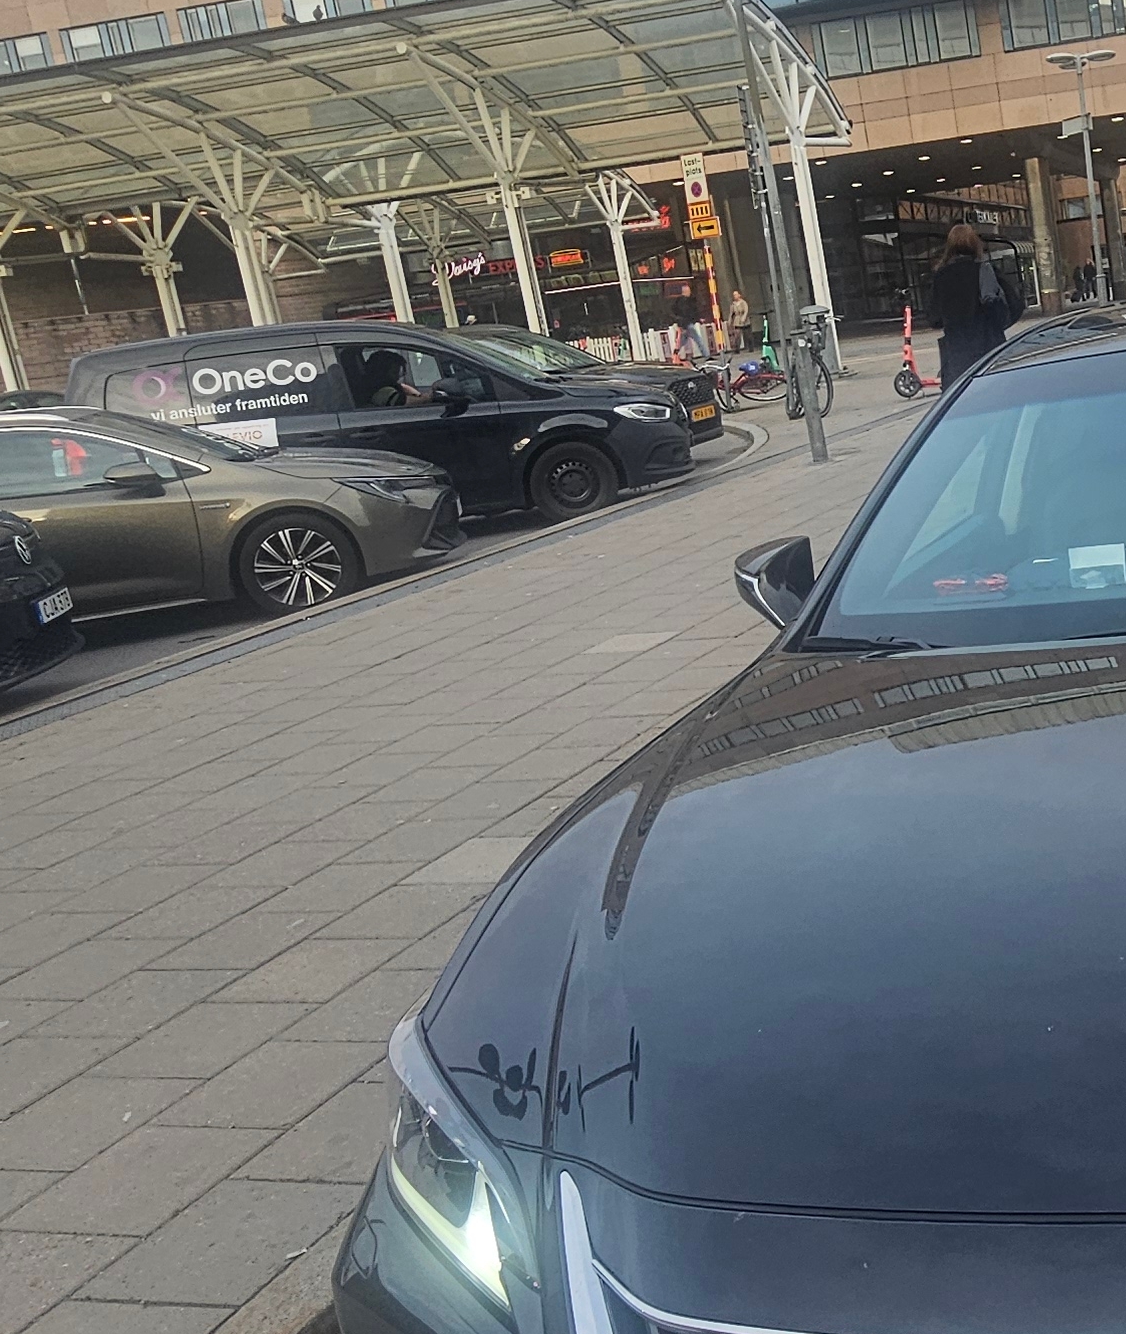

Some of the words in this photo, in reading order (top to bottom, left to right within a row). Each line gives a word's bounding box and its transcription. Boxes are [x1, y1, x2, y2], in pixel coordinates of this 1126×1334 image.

[683, 157, 701, 167] Last-
[192, 359, 318, 395] OneCo
[151, 407, 166, 422] vi
[170, 401, 233, 420] ansluter
[234, 391, 309, 412] framtiden
